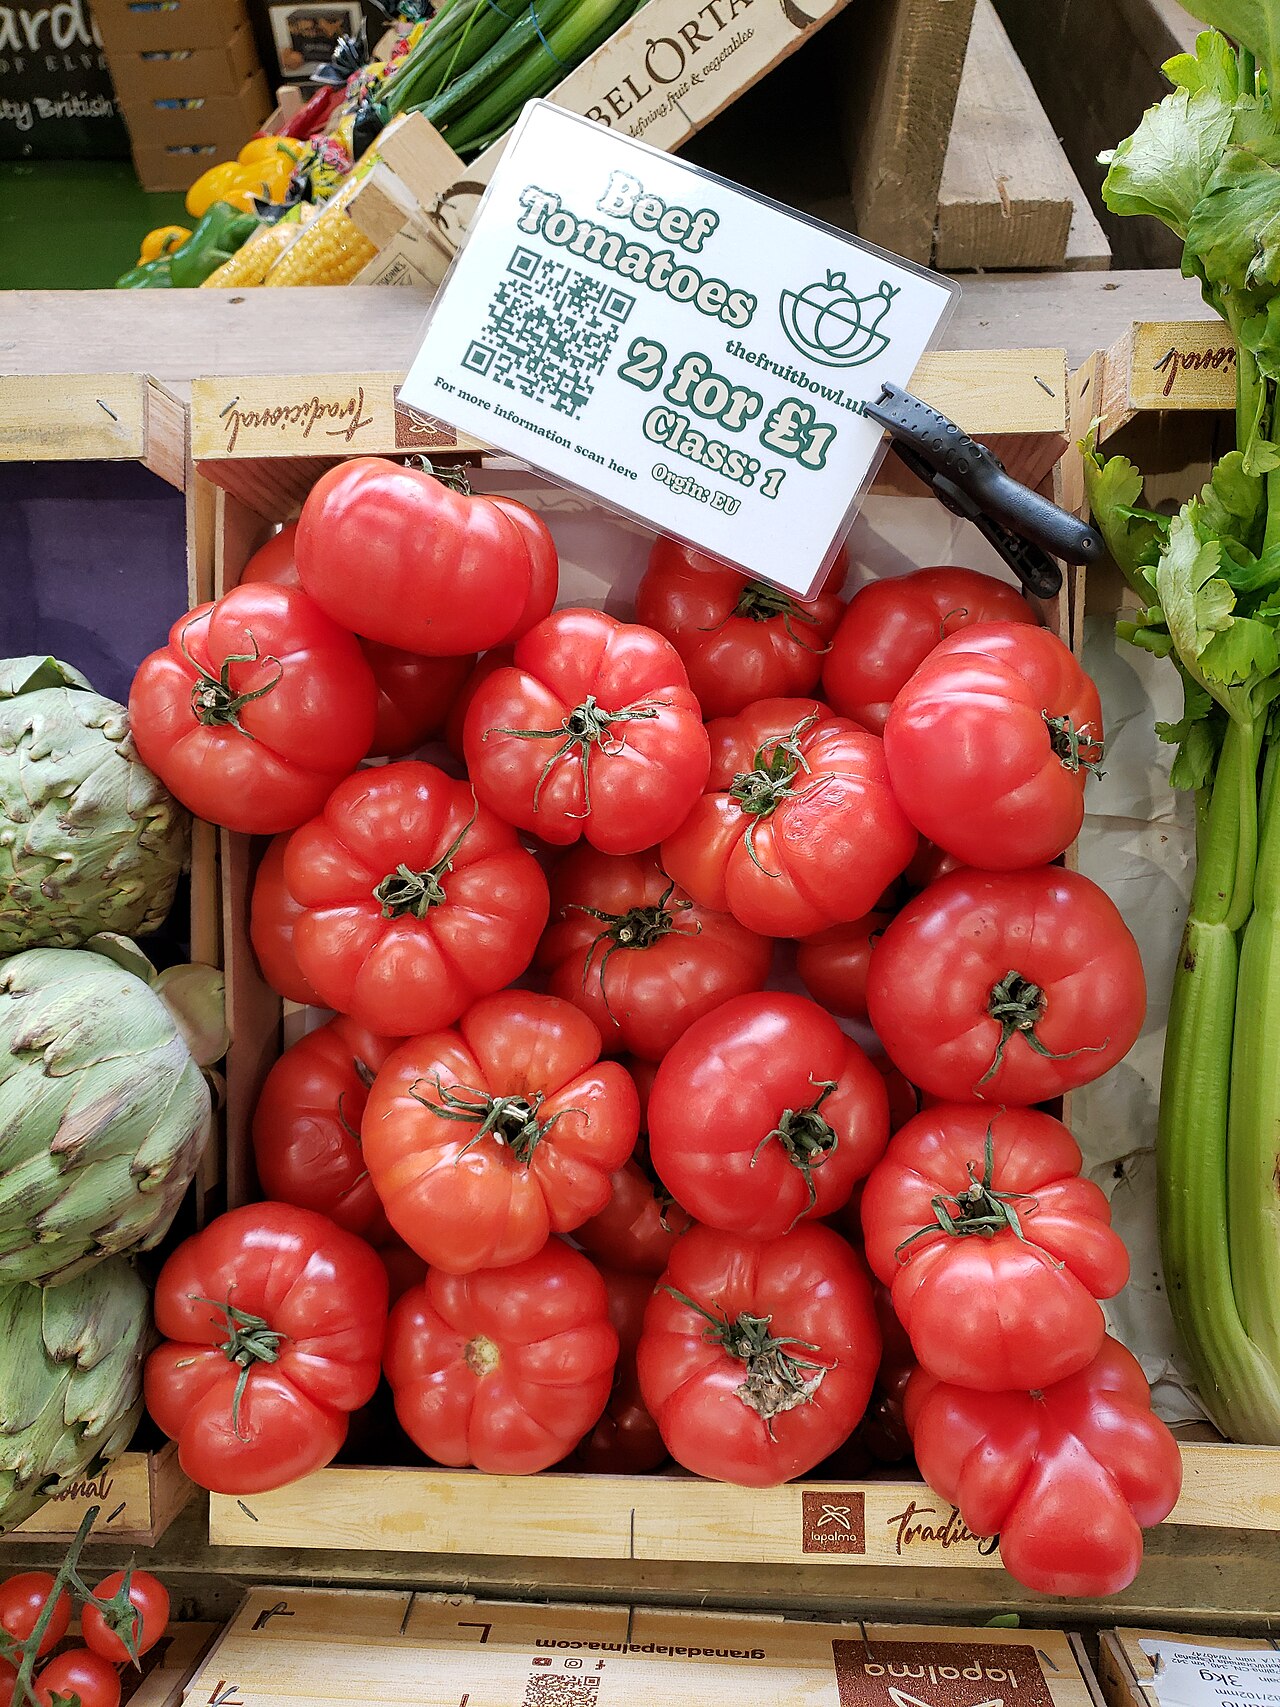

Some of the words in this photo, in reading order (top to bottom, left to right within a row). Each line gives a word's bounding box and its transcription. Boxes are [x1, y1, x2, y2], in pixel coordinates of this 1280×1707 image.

[667, 81, 691, 112] fruit
[690, 72, 705, 86] &
[702, 27, 755, 76] vegetables
[596, 169, 720, 253] Beef
[517, 184, 758, 329] Tomatoes
[224, 386, 374, 453] Tradicional
[434, 376, 456, 393] For
[457, 388, 492, 411] more
[493, 404, 572, 450] information
[574, 444, 606, 466] scan
[608, 459, 638, 481] here
[617, 336, 668, 392] 2
[663, 352, 764, 433] for
[759, 396, 838, 471] £1
[643, 405, 761, 487] Class:
[760, 468, 787, 500] 1
[651, 462, 711, 504] Orgin:
[709, 490, 742, 516] EU
[811, 1531, 857, 1545] lapalma
[535, 1638, 766, 1660] granadalapalma.com
[864, 1659, 1018, 1688] lapalma
[1199, 1668, 1243, 1687] 3kg
